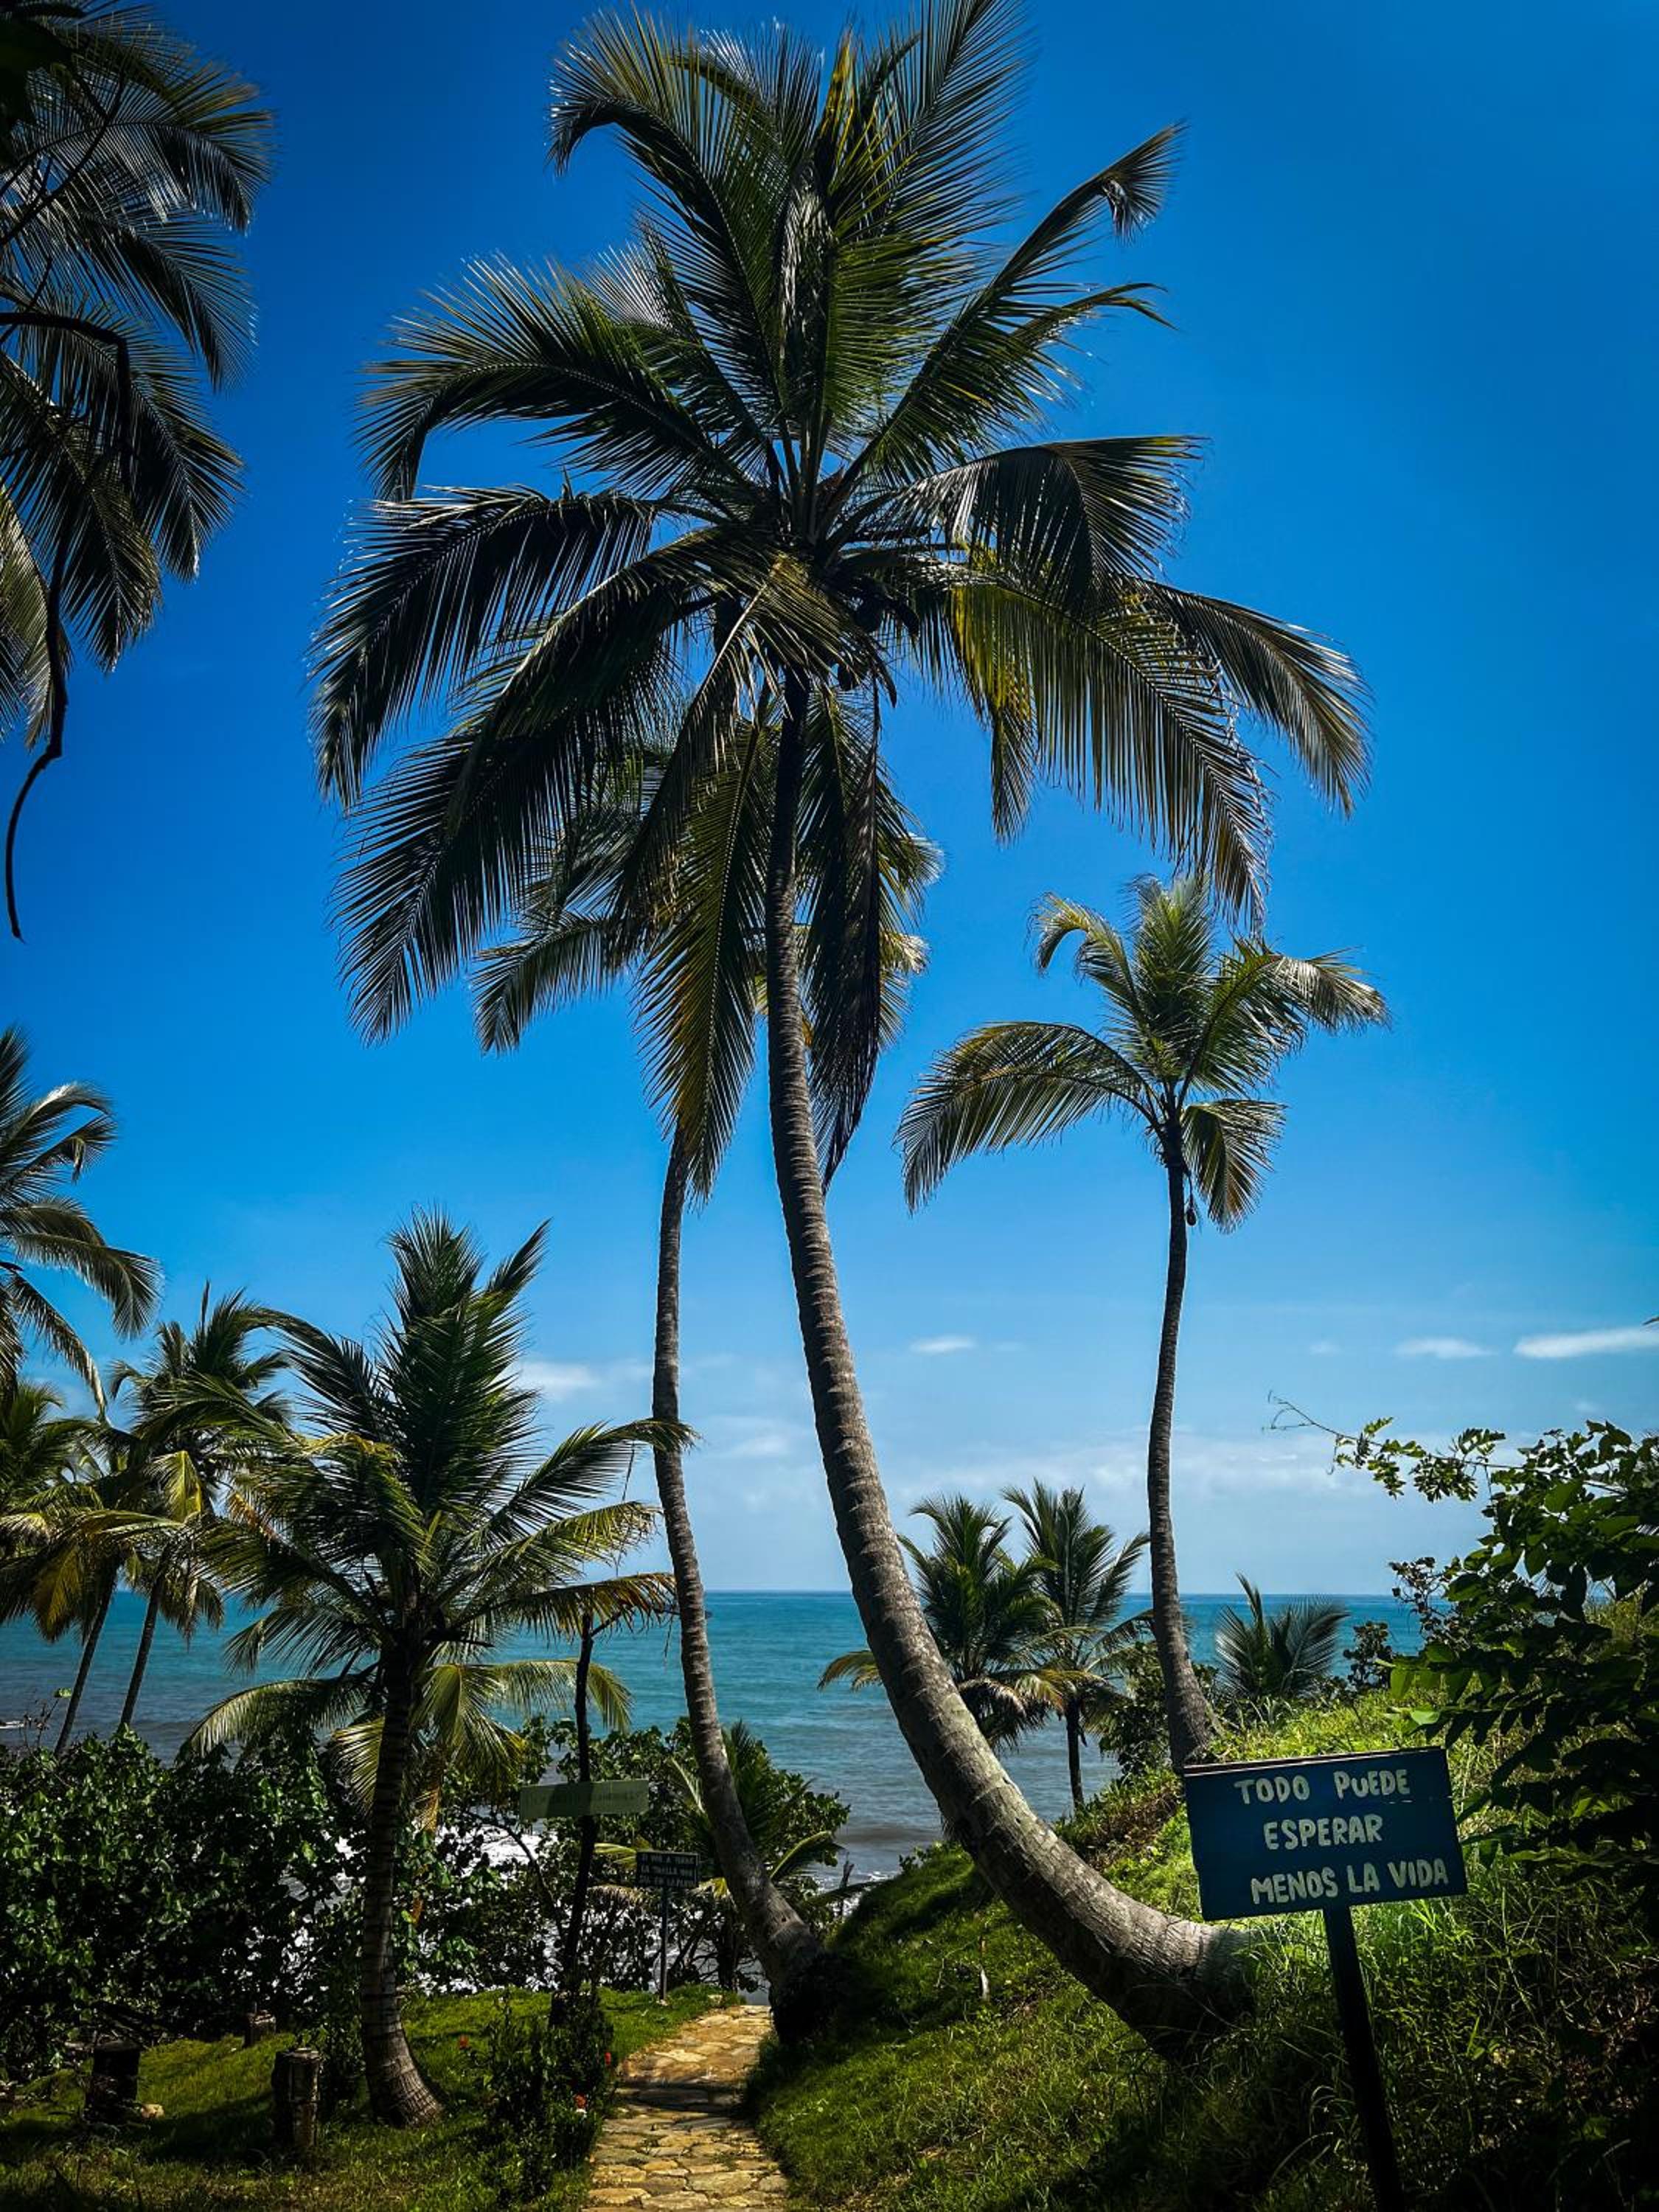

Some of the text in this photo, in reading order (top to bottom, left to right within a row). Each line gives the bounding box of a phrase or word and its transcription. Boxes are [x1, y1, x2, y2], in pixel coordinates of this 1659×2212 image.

[1234, 1770, 1411, 1804] TODO PUEDE
[1264, 1814, 1383, 1850] ESPERAR
[1251, 1858, 1448, 1905] MENOS LA VIDA
